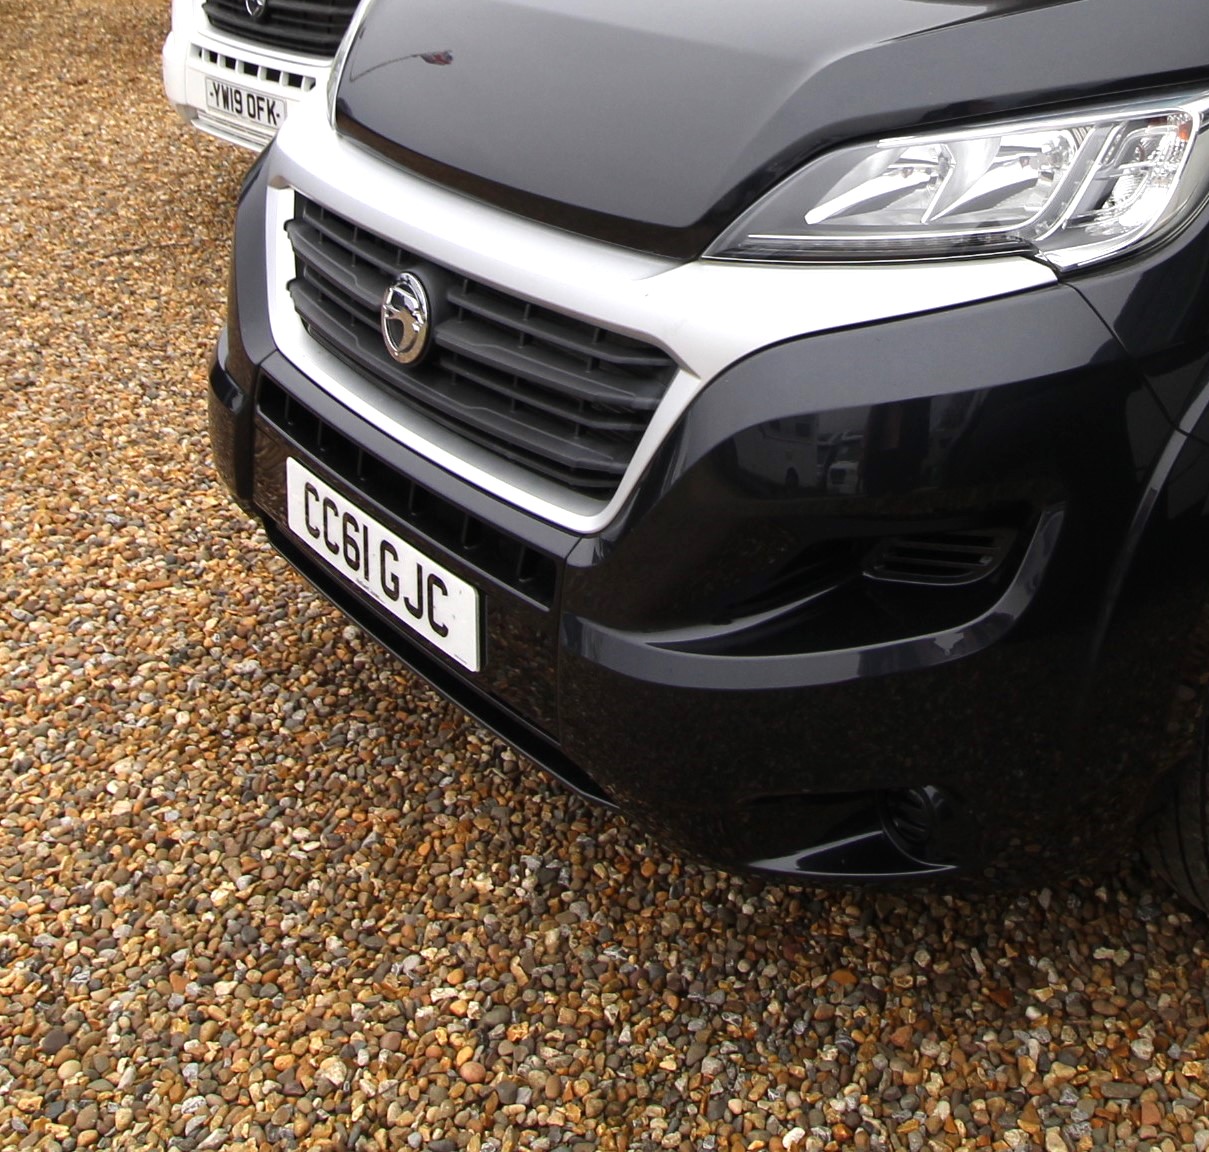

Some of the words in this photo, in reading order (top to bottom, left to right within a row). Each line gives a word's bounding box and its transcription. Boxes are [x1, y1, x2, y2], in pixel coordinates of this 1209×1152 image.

[213, 81, 243, 115] YW19
[247, 93, 278, 126] OFK
[304, 481, 370, 582] CC61
[380, 539, 449, 639] GJC
